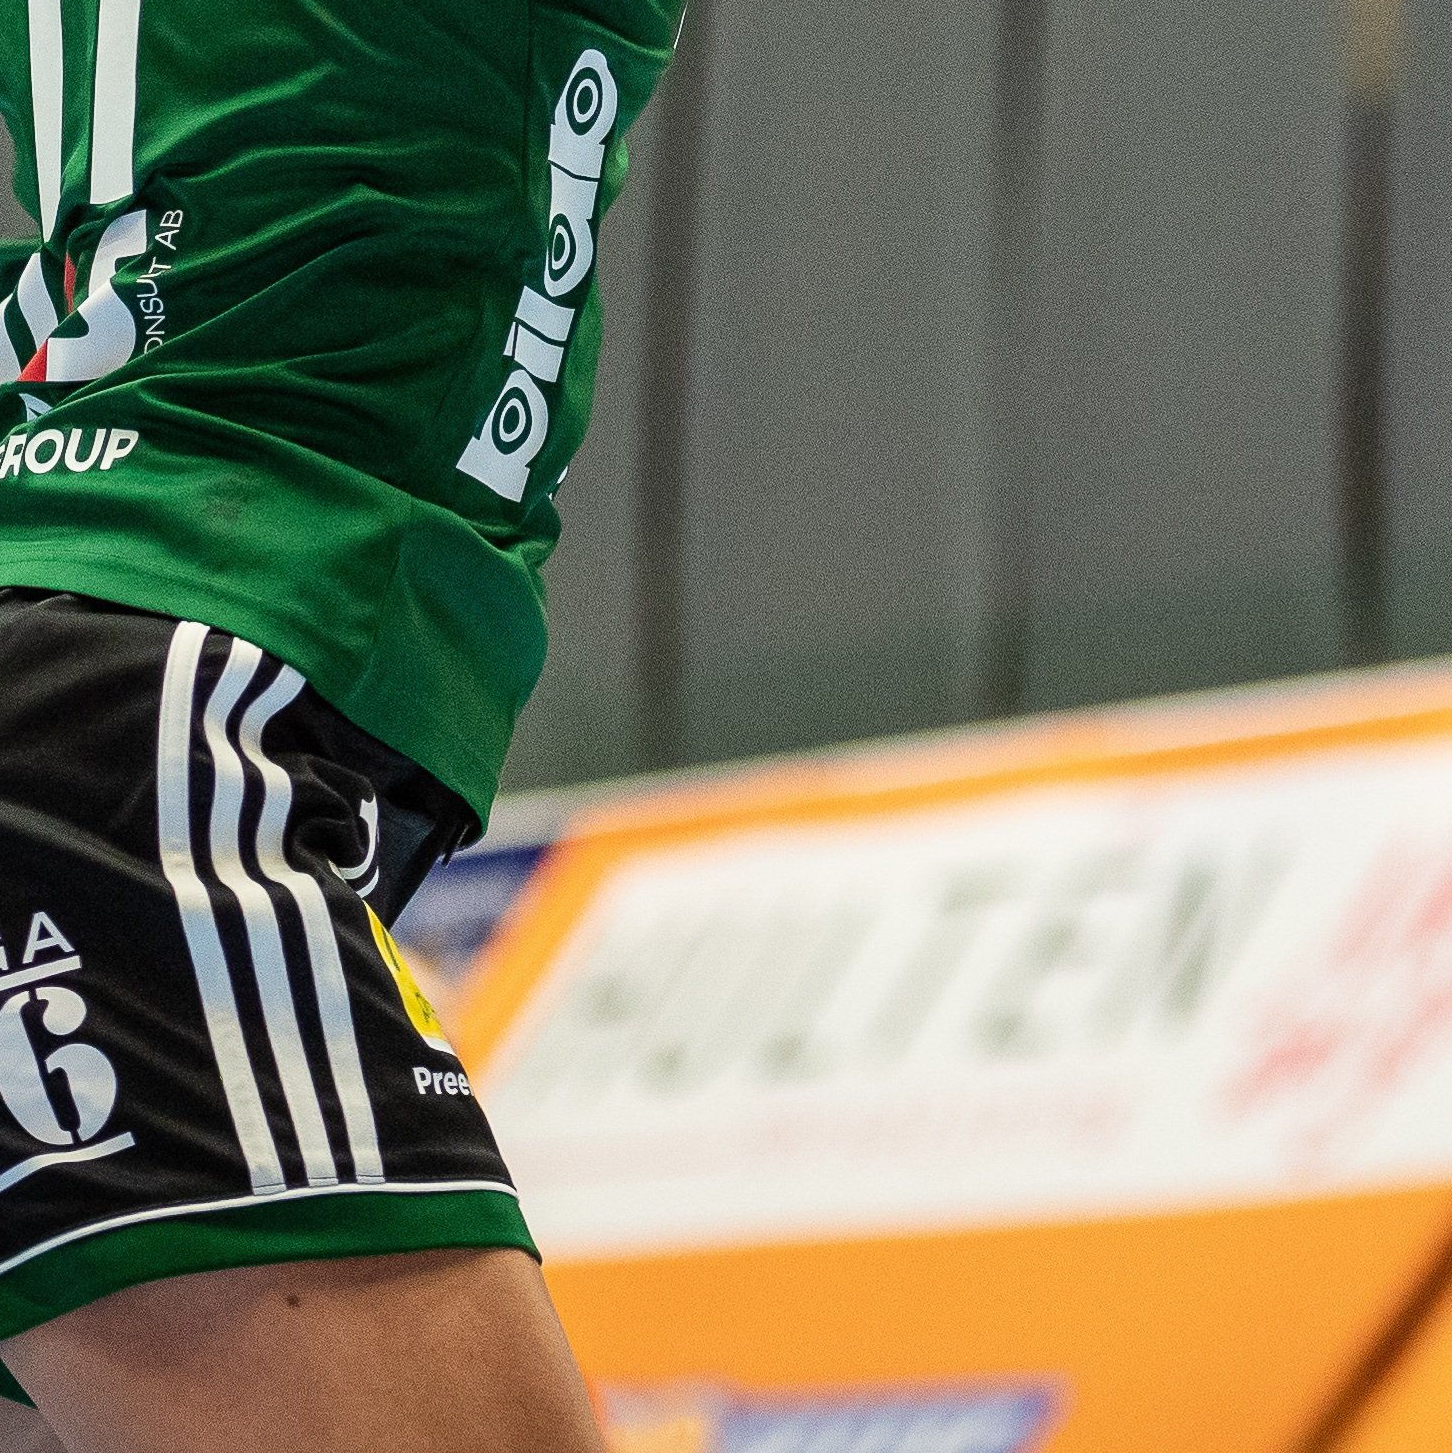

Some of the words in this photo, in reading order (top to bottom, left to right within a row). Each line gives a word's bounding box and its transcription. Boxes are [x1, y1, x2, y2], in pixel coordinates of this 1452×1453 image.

[136, 256, 172, 355] ONSULT
[154, 209, 184, 251] AB
[412, 1066, 476, 1097] Pree
